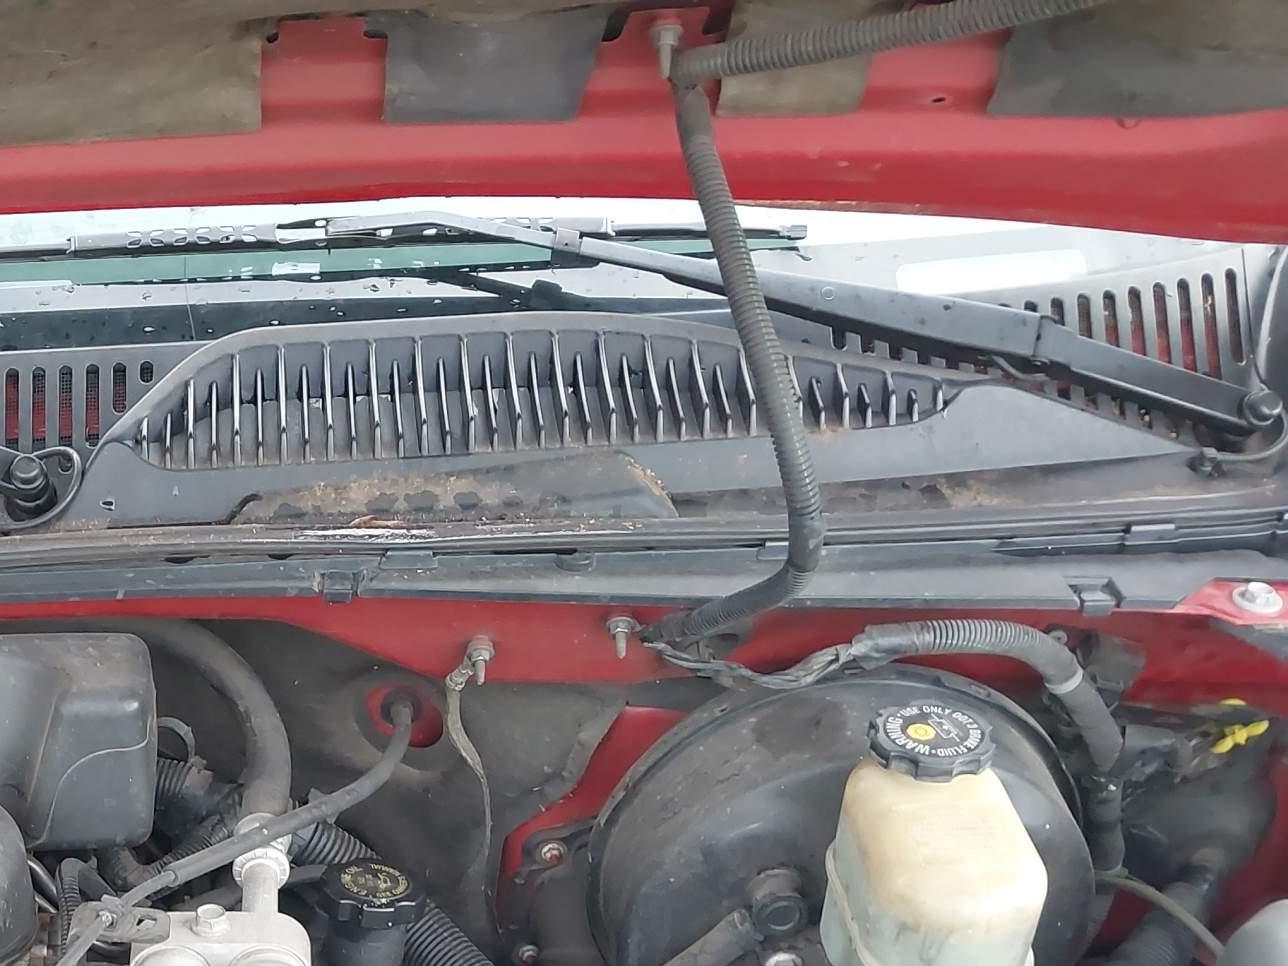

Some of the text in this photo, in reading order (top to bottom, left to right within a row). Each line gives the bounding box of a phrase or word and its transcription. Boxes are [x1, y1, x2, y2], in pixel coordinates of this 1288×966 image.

[922, 705, 953, 715] ONLY
[886, 716, 930, 756] WARNING
[936, 744, 967, 757] FLUID
